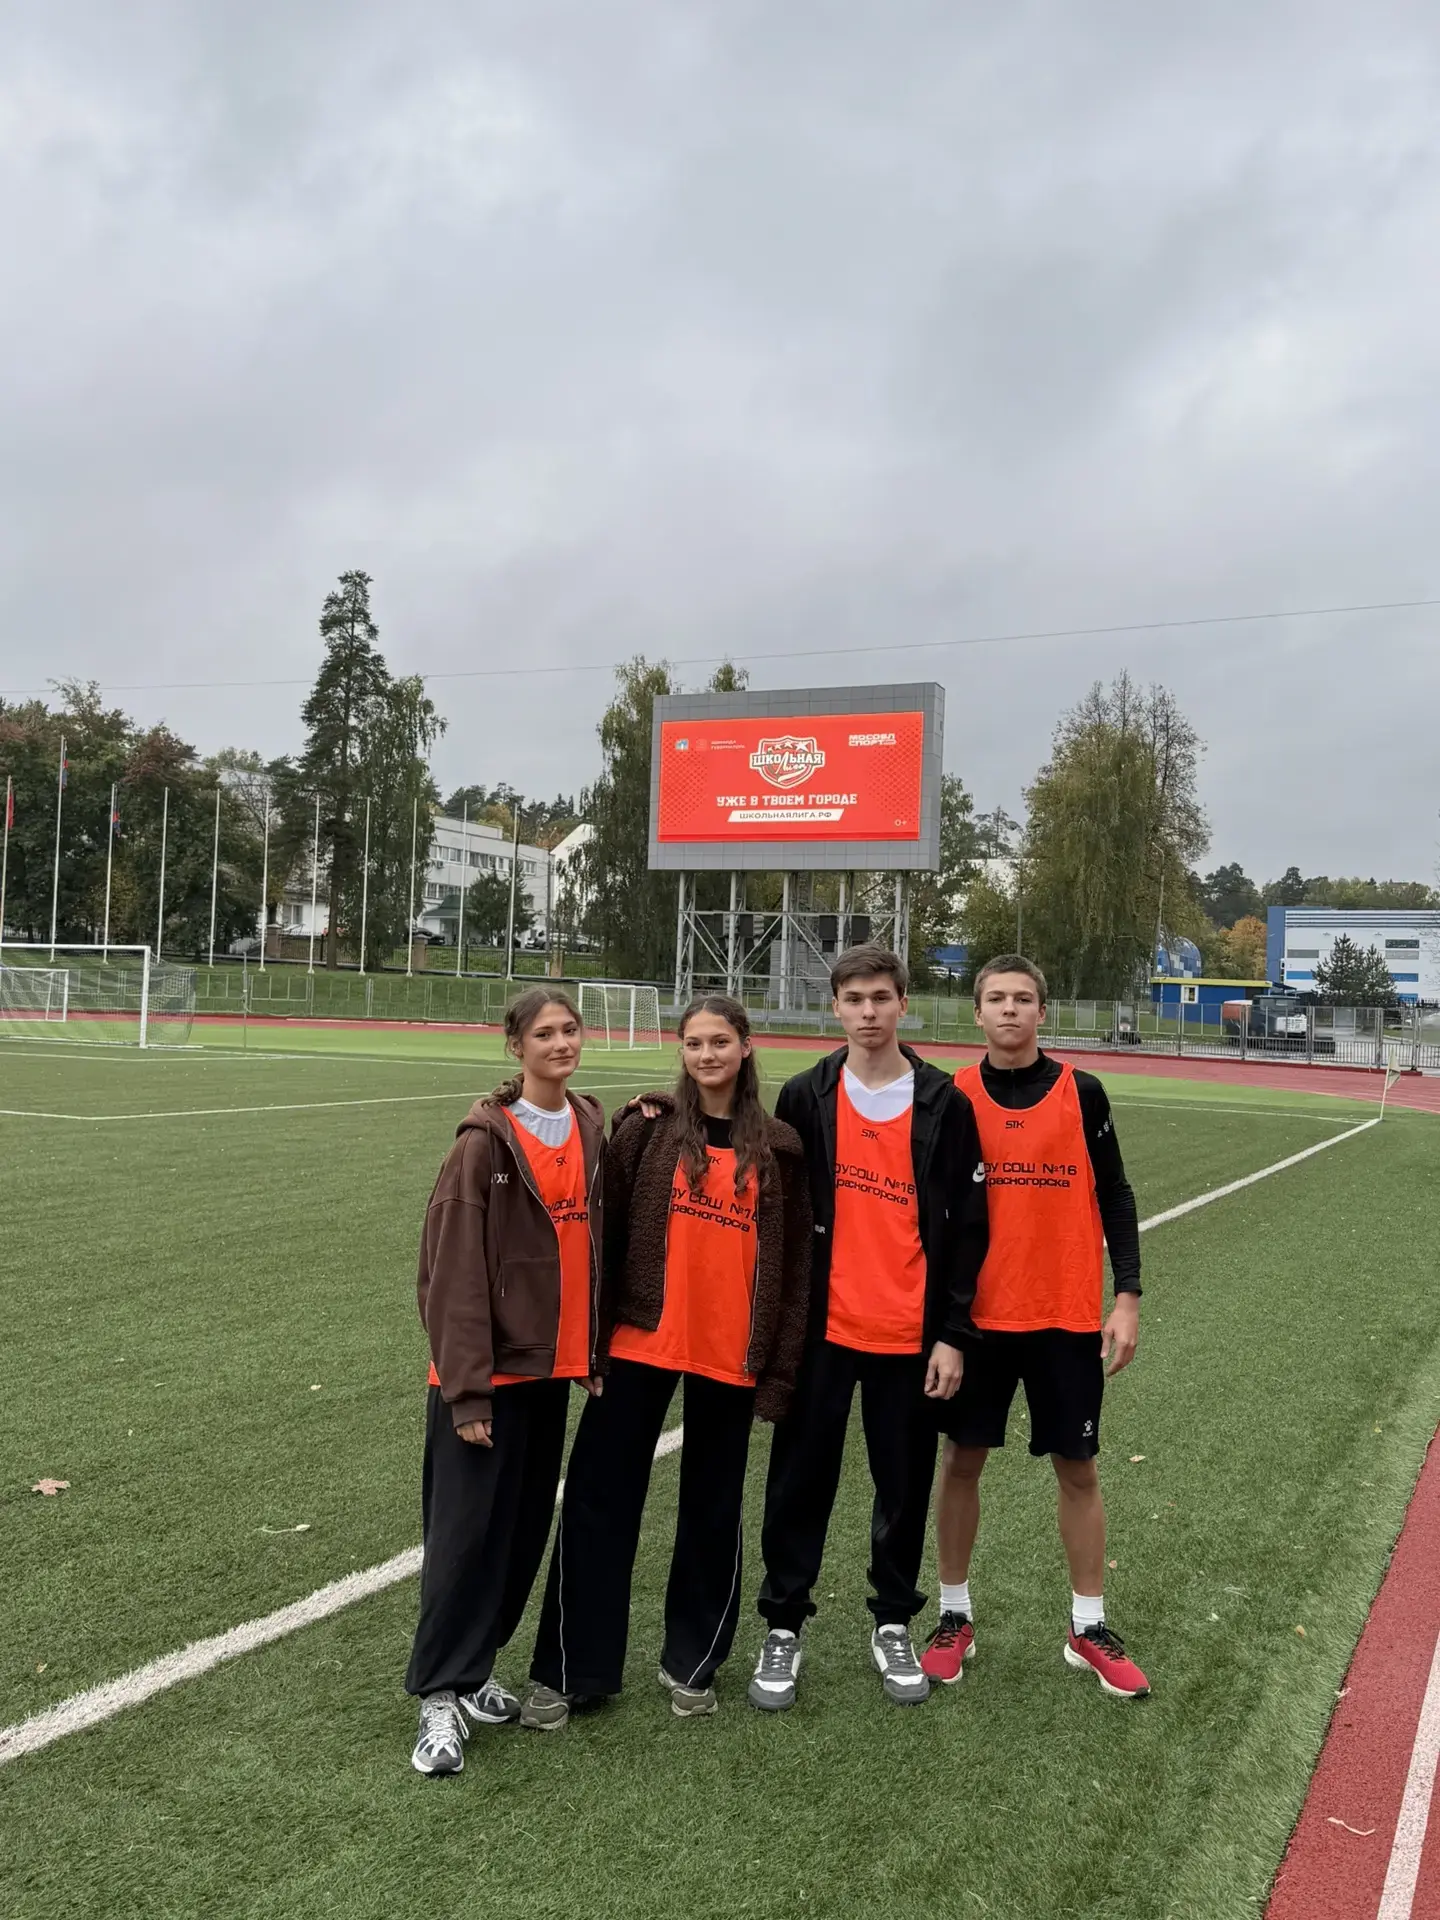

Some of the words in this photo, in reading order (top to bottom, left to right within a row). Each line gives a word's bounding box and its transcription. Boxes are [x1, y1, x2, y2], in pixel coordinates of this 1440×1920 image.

[753, 752, 822, 766] ШКОЛЬНАЯ
[716, 795, 746, 807] УЖЕ
[750, 795, 759, 807] В
[763, 794, 805, 806] ТВОЕМ
[808, 792, 858, 805] ГОРОДЕ
[739, 810, 833, 820] ШКОЛЬНАЯЛИГА.РФ
[894, 818, 907, 828] 0+
[1002, 1162, 1035, 1173] СОШ
[1043, 1163, 1077, 1176] №16
[834, 1176, 909, 1206] расногорска
[884, 1176, 916, 1196] №16
[671, 1203, 750, 1233] расногорска
